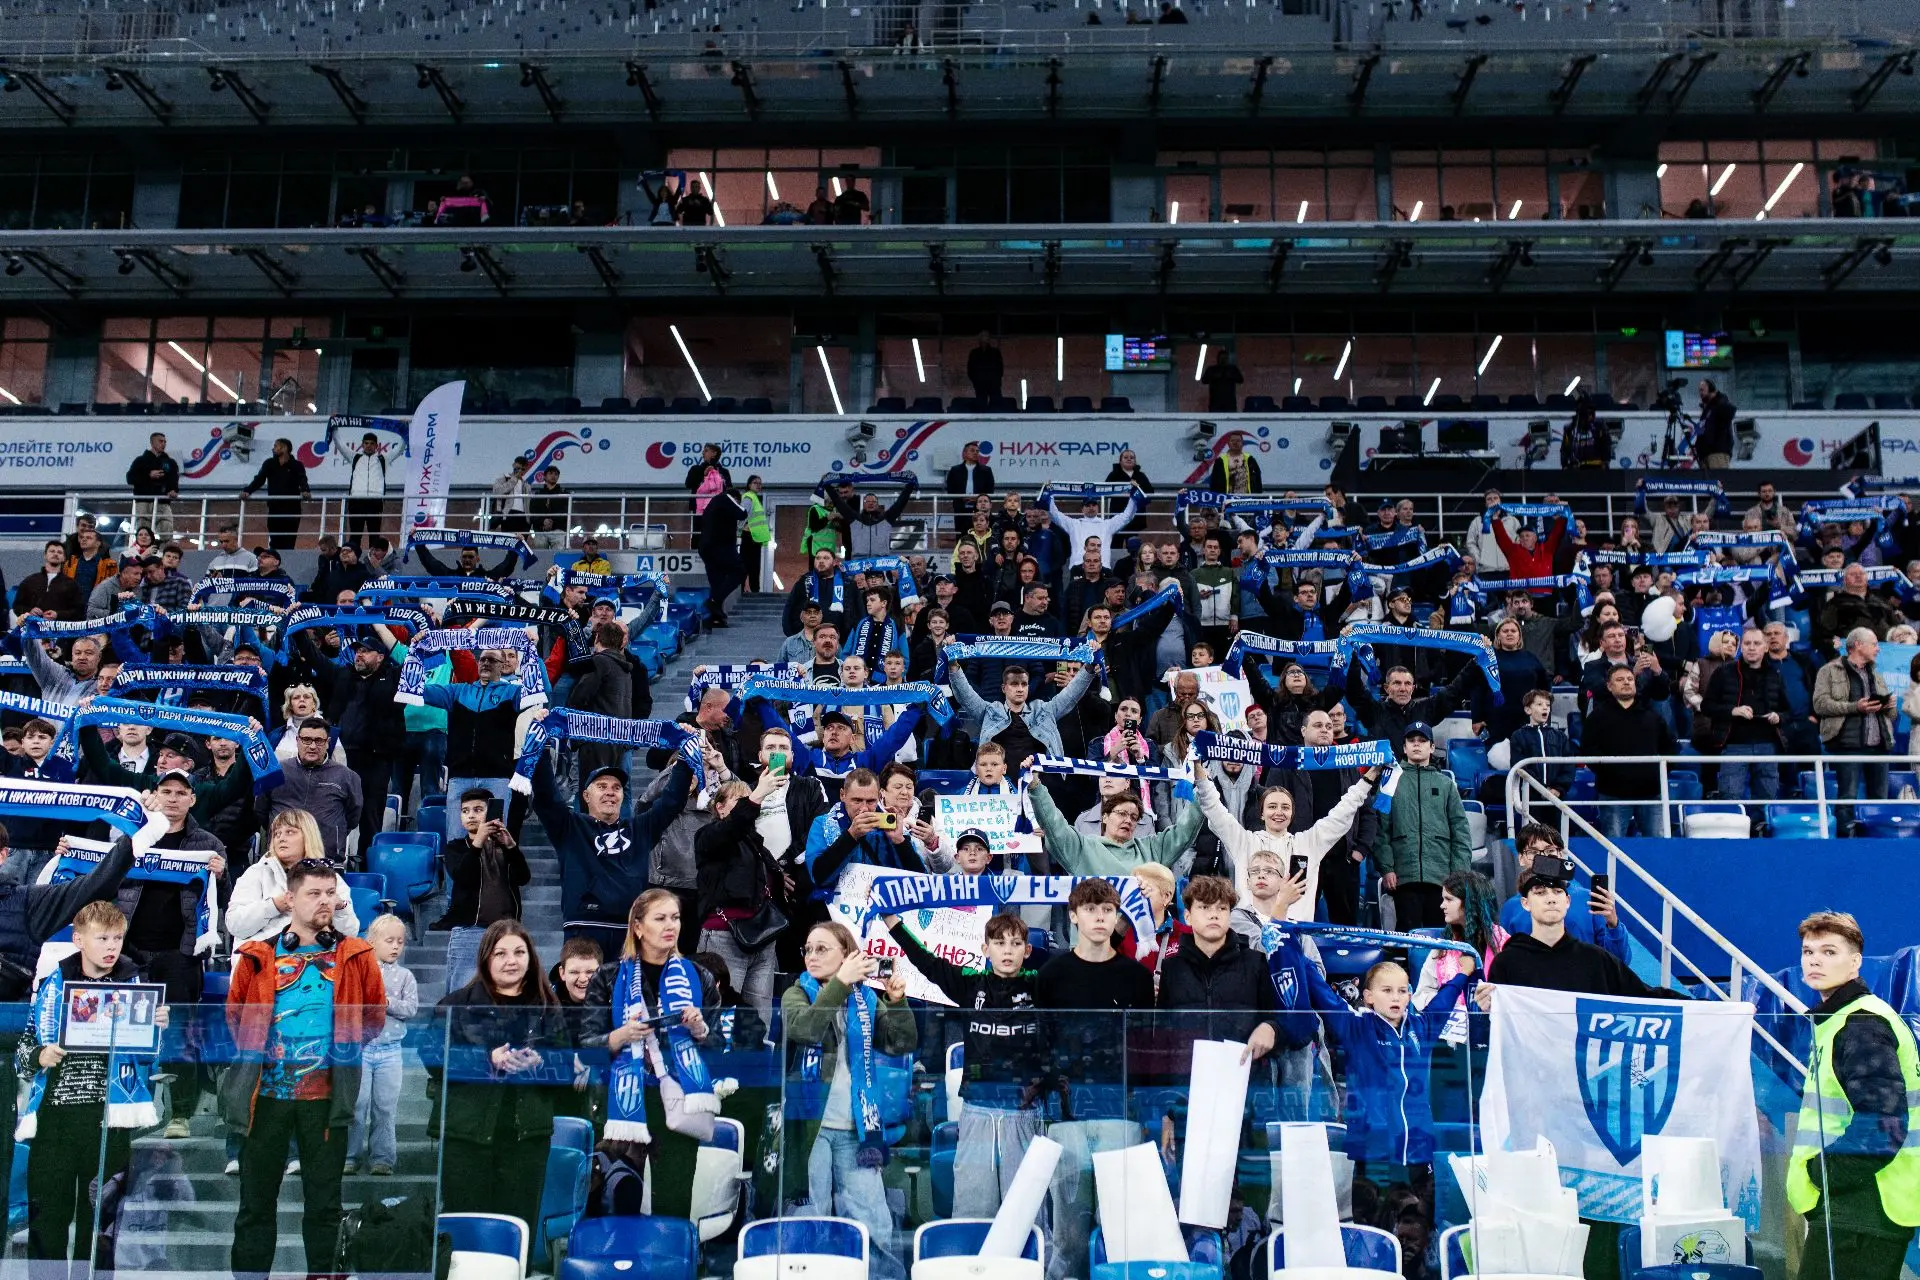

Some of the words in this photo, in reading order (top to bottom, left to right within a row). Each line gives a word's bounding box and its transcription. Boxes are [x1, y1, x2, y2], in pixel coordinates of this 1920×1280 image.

[57, 442, 113, 454] ТОЛЬКО
[683, 440, 749, 454] БОЙТЕ
[753, 442, 811, 454] ТОЛЬКО
[1000, 441, 1129, 455] НИЖФАРМ
[417, 413, 438, 507] НИЖФАРМ
[682, 456, 771, 468] ФУОЛОМ!
[1000, 459, 1060, 467] ГРУППА
[658, 556, 693, 571] 105
[570, 577, 602, 587] НОВГОРОД
[186, 611, 229, 623] НИЖНИЙ
[289, 605, 322, 626] ЖНИЙ
[454, 602, 569, 622] НИЖЕГОРОДЦЫ
[1382, 625, 1401, 635] КЛУБ
[117, 670, 144, 686] ПАРИ
[146, 669, 196, 681] НИЖНИЙ
[197, 671, 254, 686] НОВГОРОД
[754, 679, 806, 691] ФУТБОЛЬНЫЙ
[899, 683, 936, 695] НОВГОРОД
[31, 697, 40, 711] И
[111, 706, 135, 715] КЛУБ
[158, 710, 181, 720] ПАРИ
[183, 714, 223, 727] НИЖНИЙ
[568, 713, 609, 740] НИЖНИЙ
[609, 718, 662, 748] НОВГОРОД
[1207, 746, 1262, 764] НОВГОРОД
[1334, 752, 1385, 766] НОВГОРОД
[9, 790, 58, 805] НИЖНИЙ
[58, 794, 117, 812] НОВГОРОД
[160, 860, 182, 872] ПАРИ
[885, 875, 946, 908] ПАРИ
[950, 875, 980, 900] НН
[1030, 876, 1060, 898] FC
[975, 997, 985, 1011] 87
[970, 1021, 1038, 1037] polaris
[1588, 1013, 1673, 1040] PARI
[860, 1011, 872, 1089] ФУТБОЛЬНЫЙ
